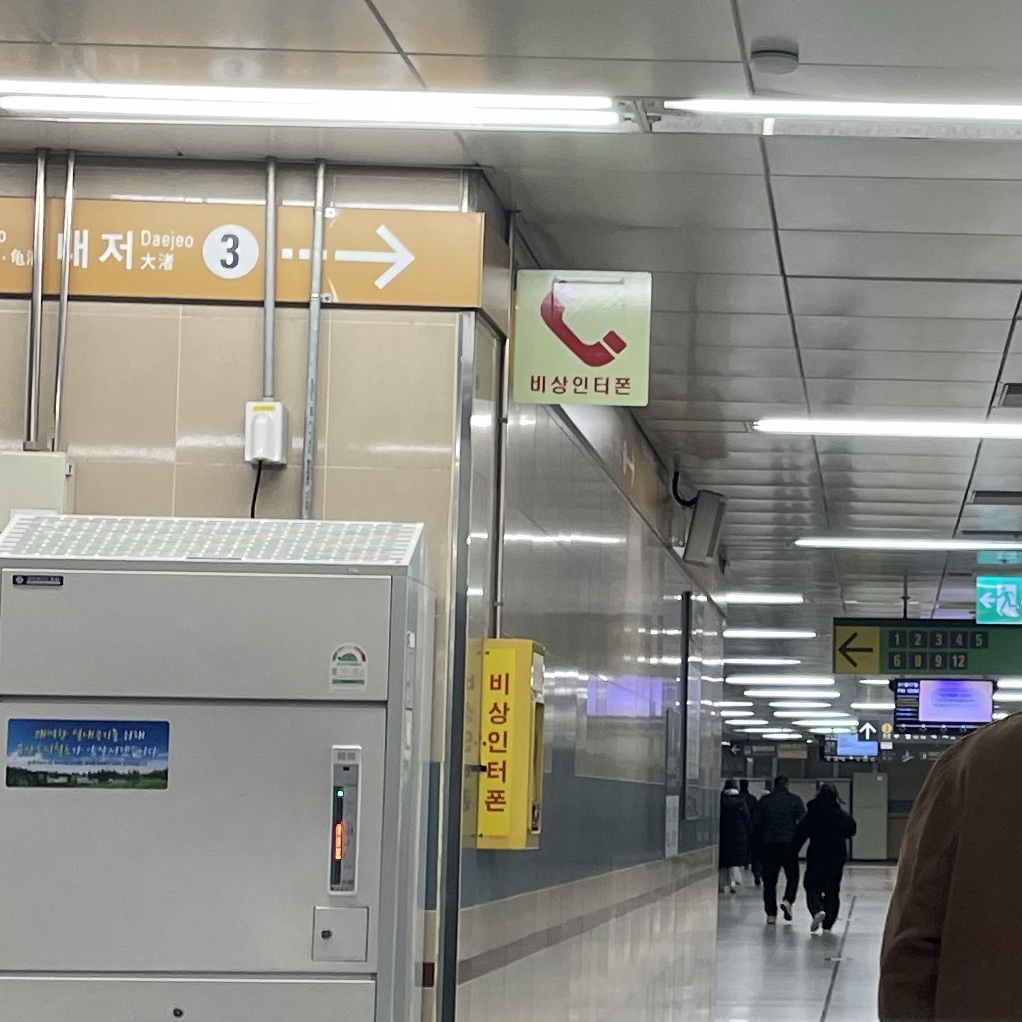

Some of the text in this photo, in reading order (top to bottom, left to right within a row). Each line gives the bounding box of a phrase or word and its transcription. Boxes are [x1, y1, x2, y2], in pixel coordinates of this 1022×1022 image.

[140, 229, 194, 251] Daejeo
[219, 233, 240, 269] 3
[530, 375, 631, 396] 비상인터폰
[894, 632, 983, 647] 1 2 3 4 5
[893, 654, 901, 667] 6
[935, 654, 943, 668] 9
[952, 654, 966, 668] 12
[485, 673, 511, 812] 비상인터폰
